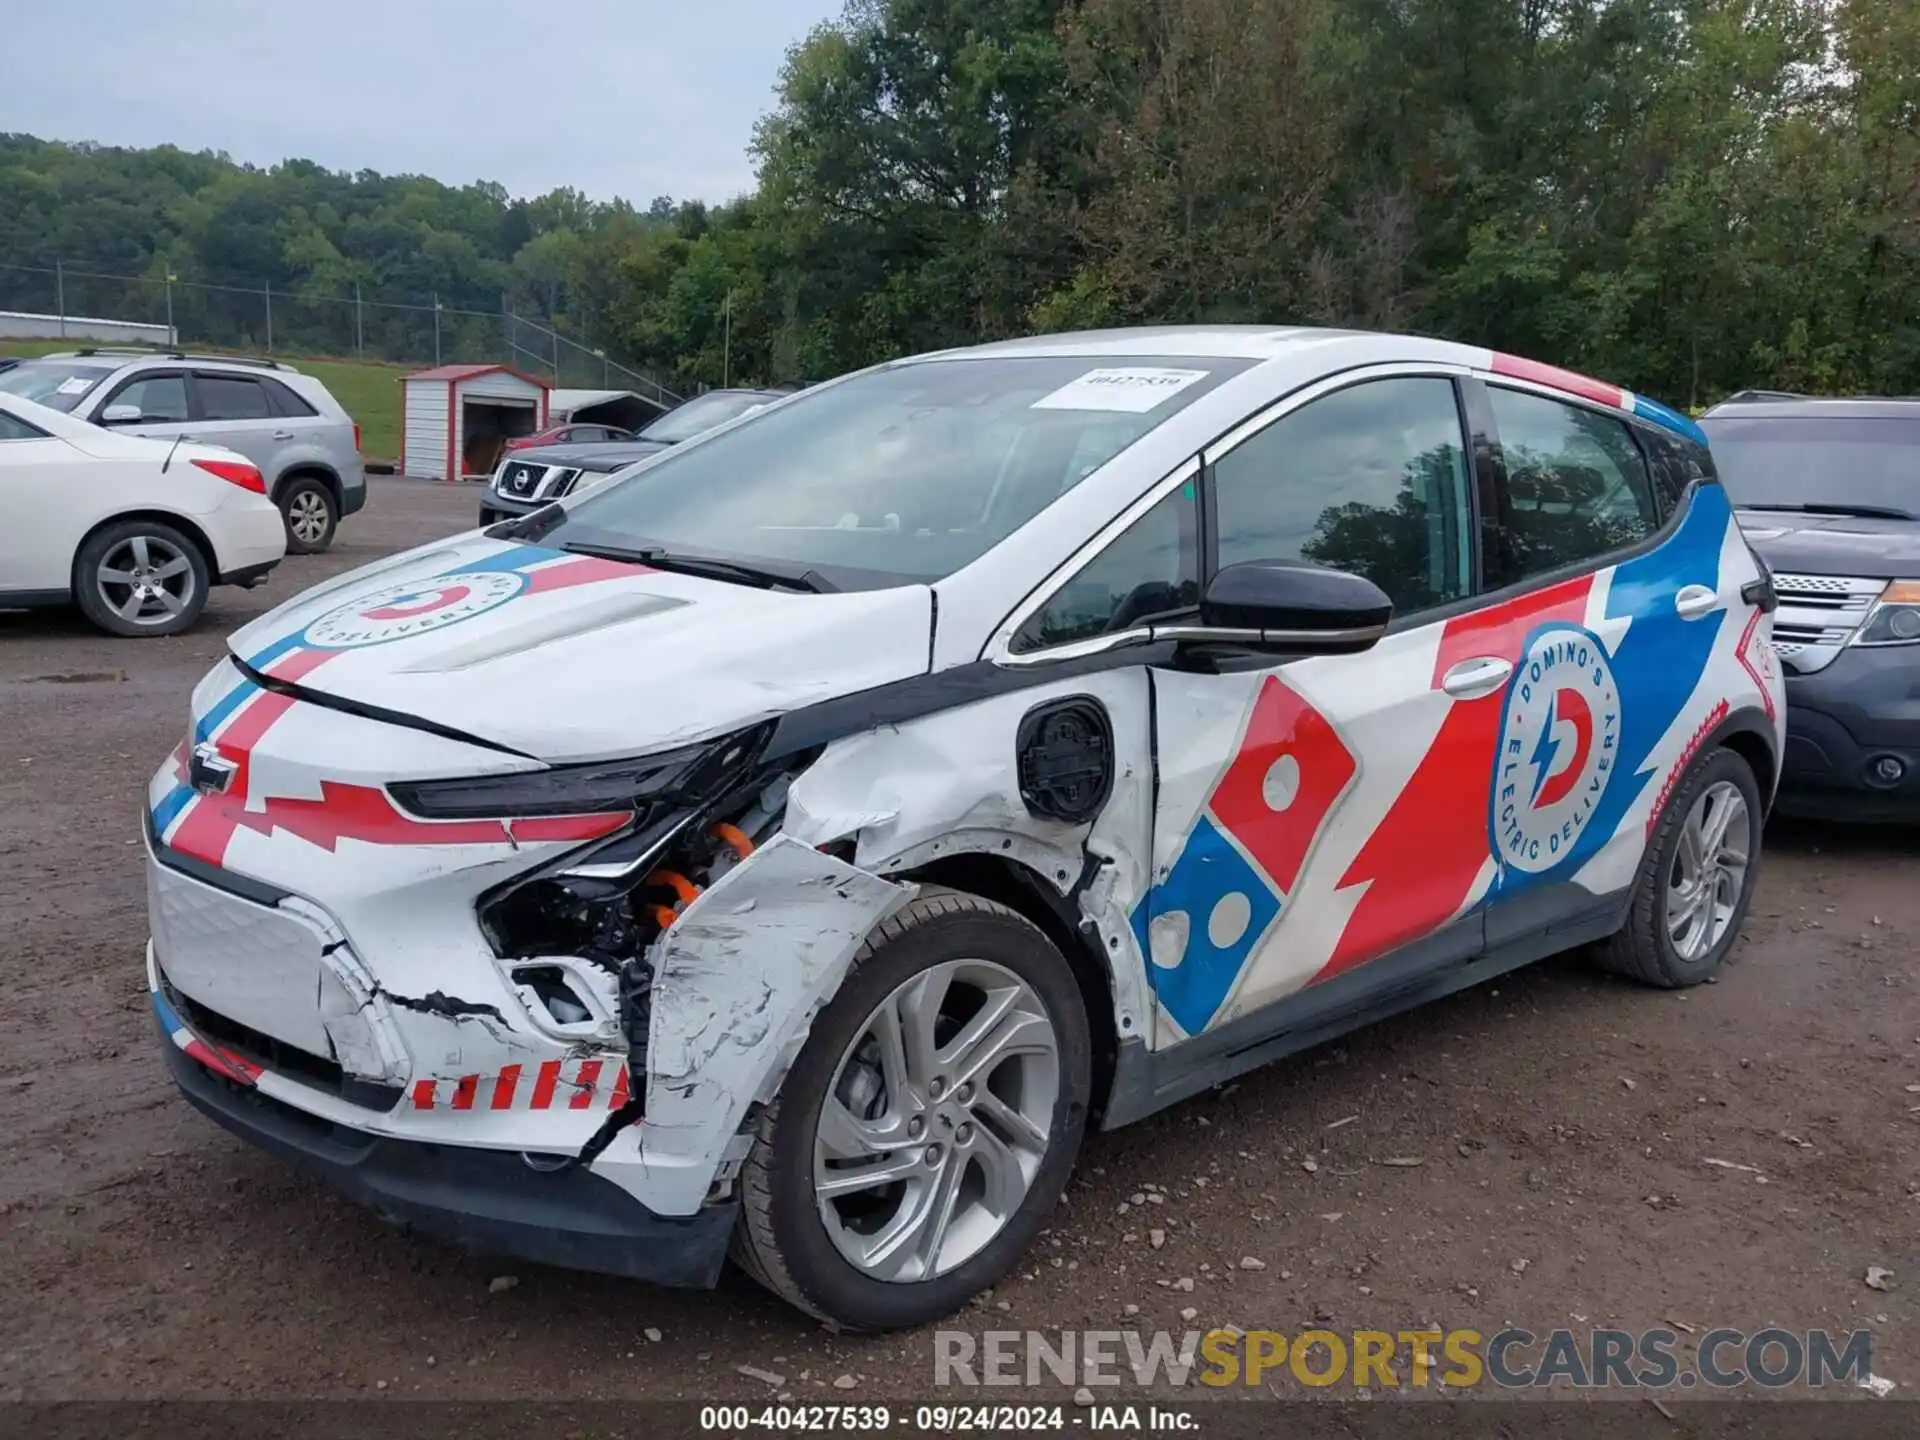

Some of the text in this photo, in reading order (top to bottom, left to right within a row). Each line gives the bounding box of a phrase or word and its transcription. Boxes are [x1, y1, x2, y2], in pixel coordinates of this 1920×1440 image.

[1520, 640, 1603, 704] DOMINO'S
[1501, 712, 1616, 861] ELECTRIC DELIVERY
